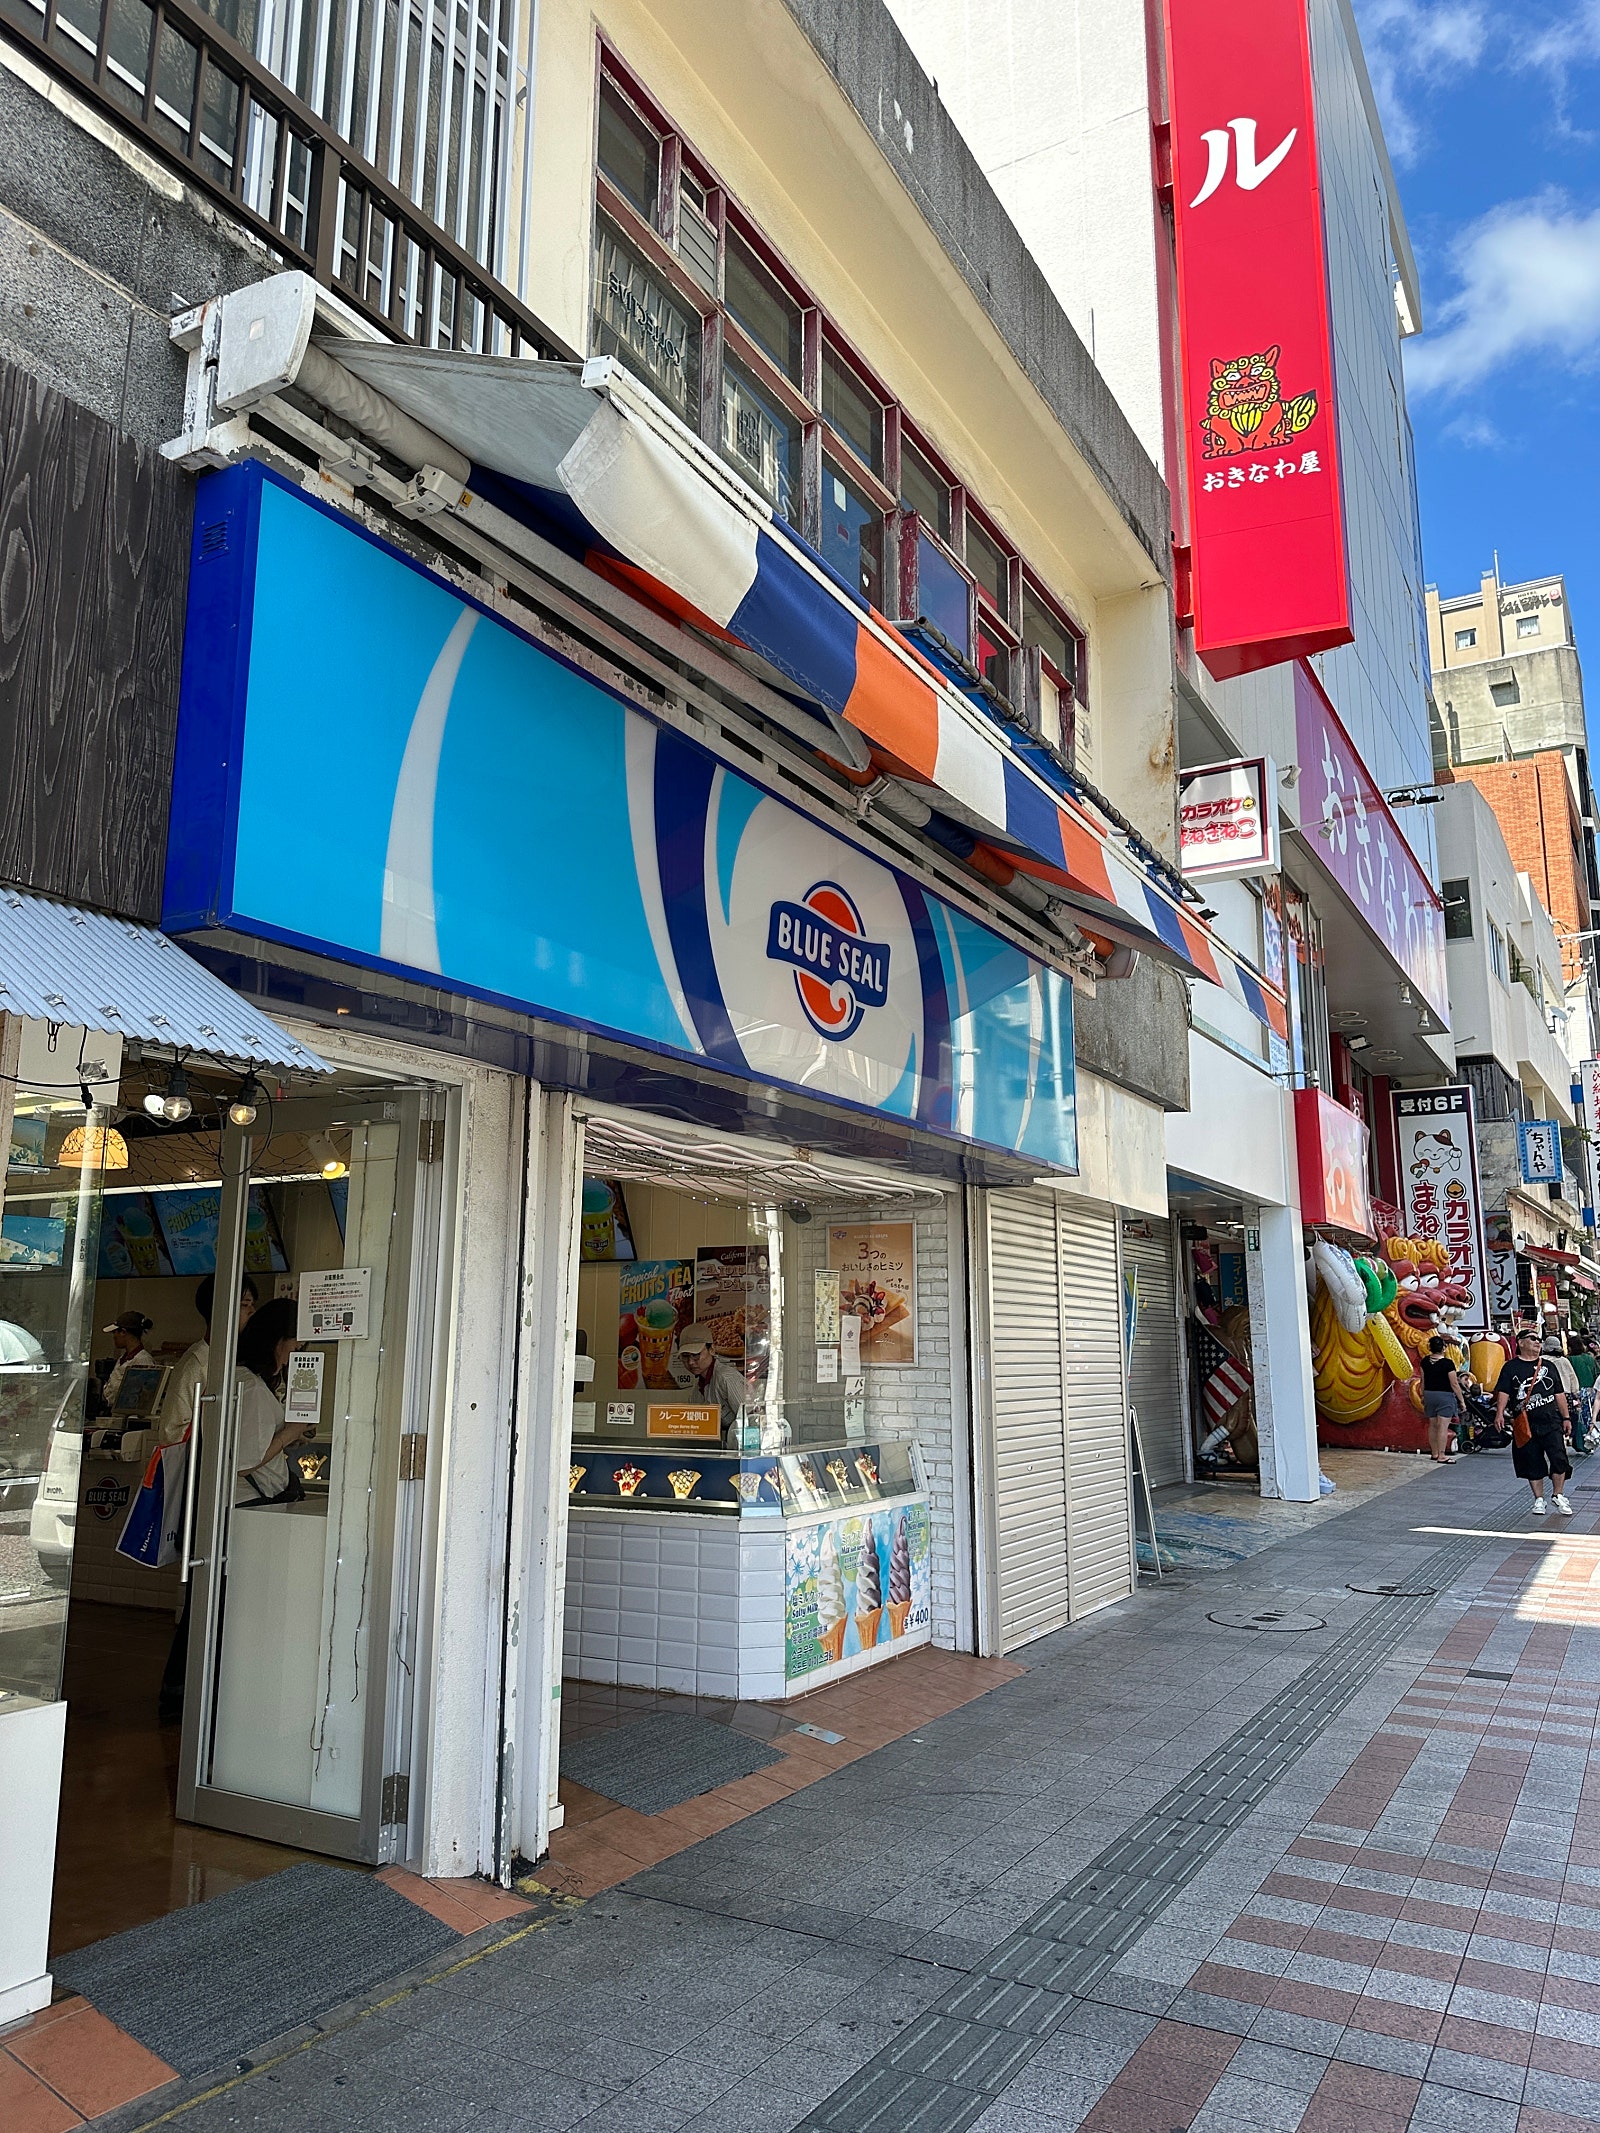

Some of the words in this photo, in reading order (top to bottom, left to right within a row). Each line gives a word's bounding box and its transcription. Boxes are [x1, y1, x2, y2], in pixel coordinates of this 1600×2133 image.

[1188, 117, 1297, 208] ル
[1202, 450, 1322, 492] おきなわ屋
[1180, 797, 1242, 823] カラオケ
[778, 912, 832, 969] BLUE
[838, 942, 883, 993] SEAL
[1401, 1095, 1463, 1113] 受付6F
[1530, 1132, 1547, 1173] ちゃんや
[1411, 1182, 1441, 1243] まね
[858, 1242, 886, 1260] 3つの
[1444, 1201, 1476, 1287] カラオケ
[620, 1265, 658, 1285] Tropical
[842, 1262, 904, 1272] おいしさのヒミツ
[1233, 1256, 1244, 1307] コインロッ
[1492, 1249, 1514, 1311] ラーメン
[622, 1275, 665, 1304] FRUITS
[665, 1267, 693, 1286] TEA
[669, 1285, 695, 1302] Float
[854, 1378, 863, 1408] バイト
[659, 1411, 709, 1421] クレープ提供口
[88, 1490, 107, 1502] BLUE
[108, 1490, 127, 1502] SEAL
